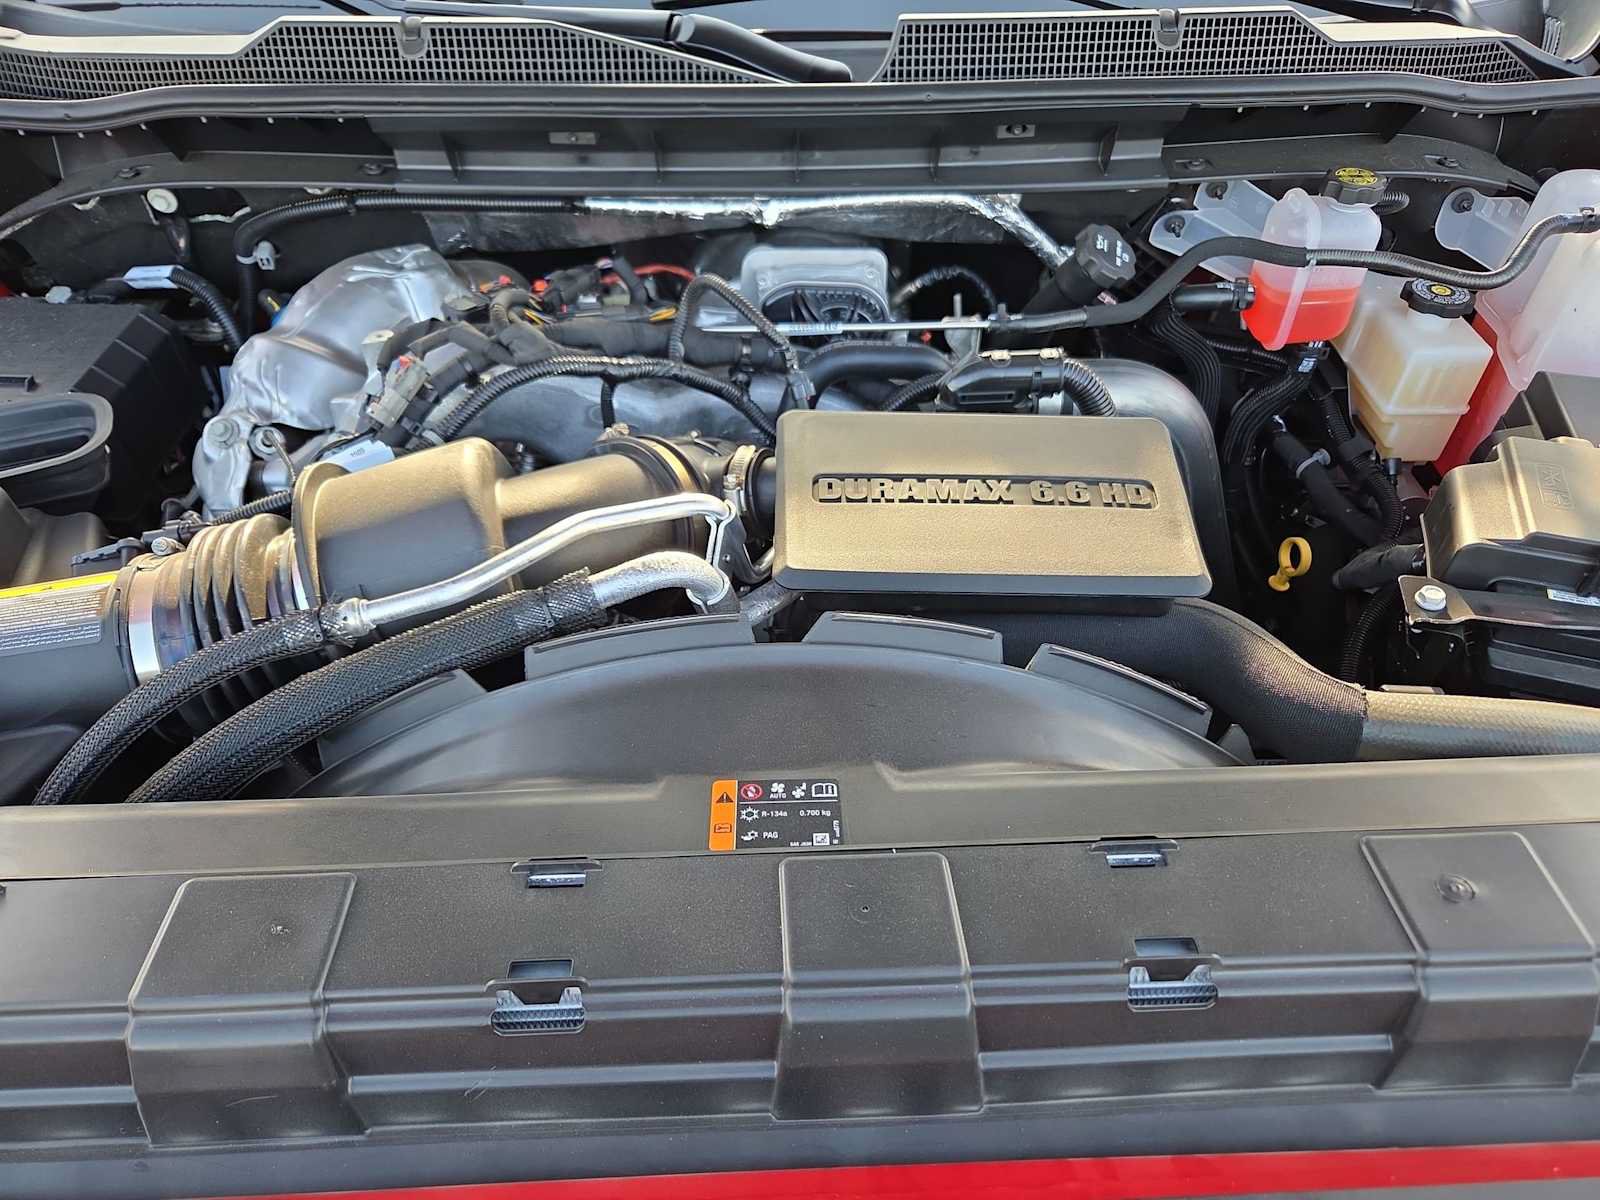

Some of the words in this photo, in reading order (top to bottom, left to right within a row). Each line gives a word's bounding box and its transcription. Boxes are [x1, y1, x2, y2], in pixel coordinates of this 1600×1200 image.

[817, 478, 1012, 504] DURAMAX
[1029, 480, 1091, 506] 6.6
[1099, 482, 1153, 508] HD
[821, 809, 831, 817] kg
